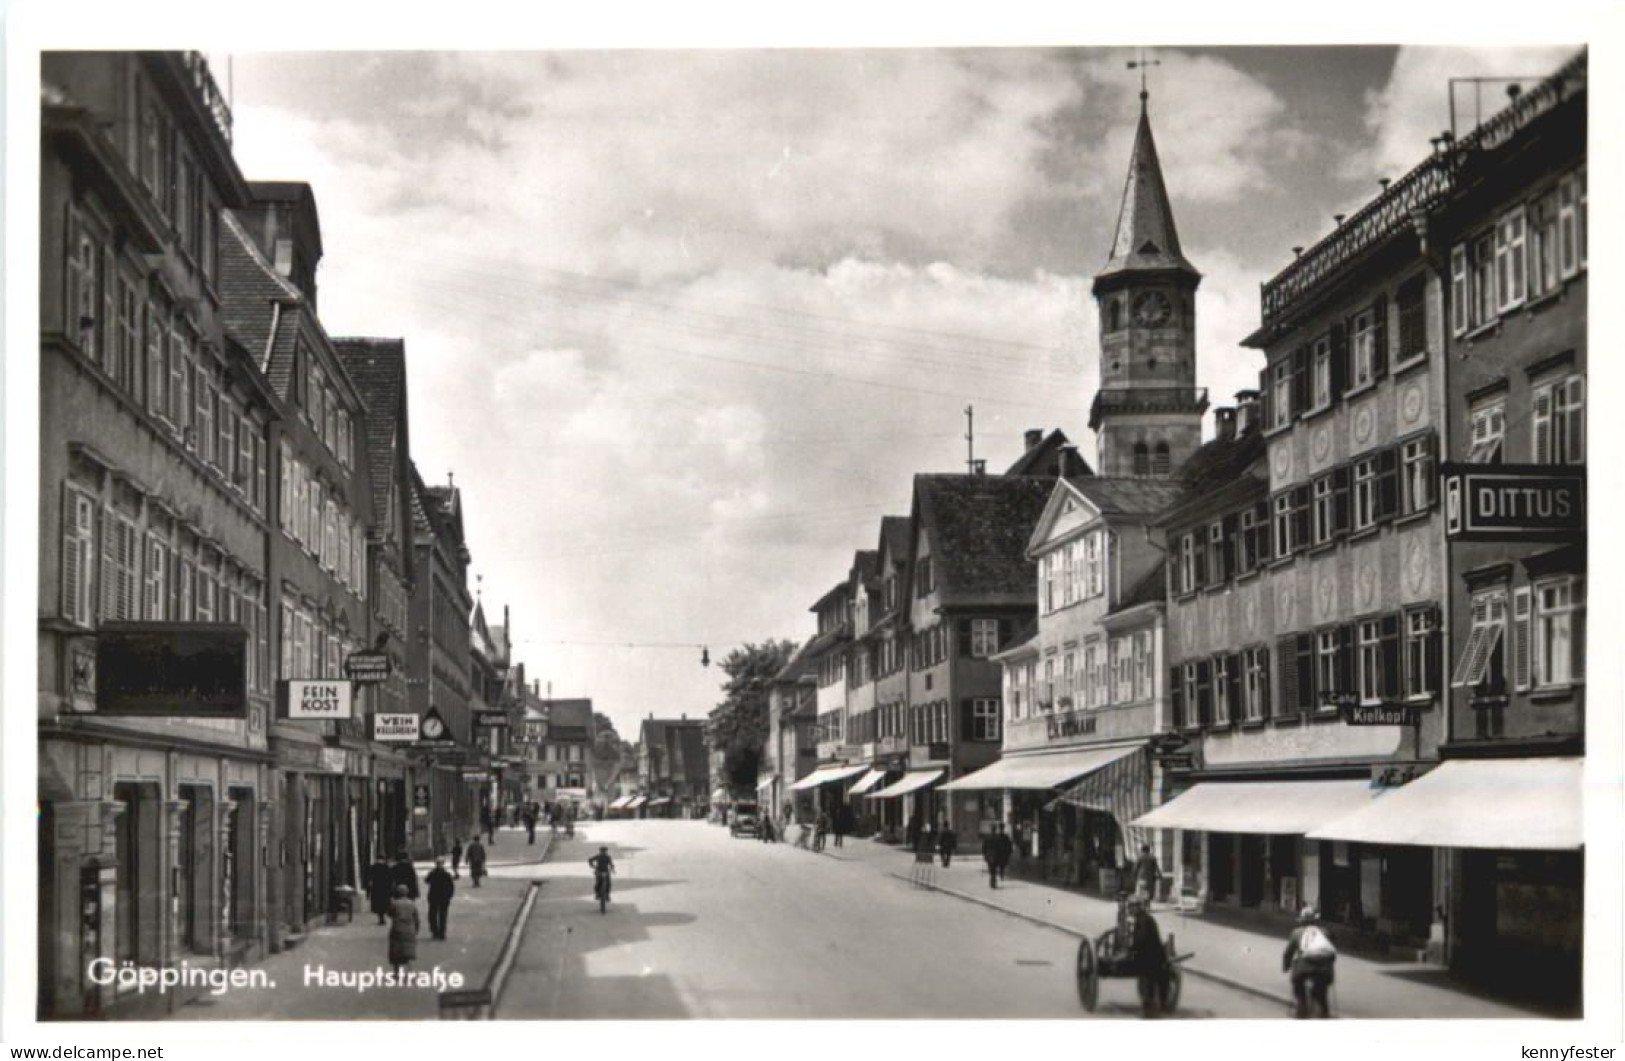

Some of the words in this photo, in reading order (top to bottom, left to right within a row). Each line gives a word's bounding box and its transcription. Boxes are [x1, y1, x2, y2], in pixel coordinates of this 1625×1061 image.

[1478, 487, 1571, 517] DITTUS
[303, 685, 337, 698] FEIN
[301, 699, 340, 711] KOST
[381, 716, 413, 725] WEIN
